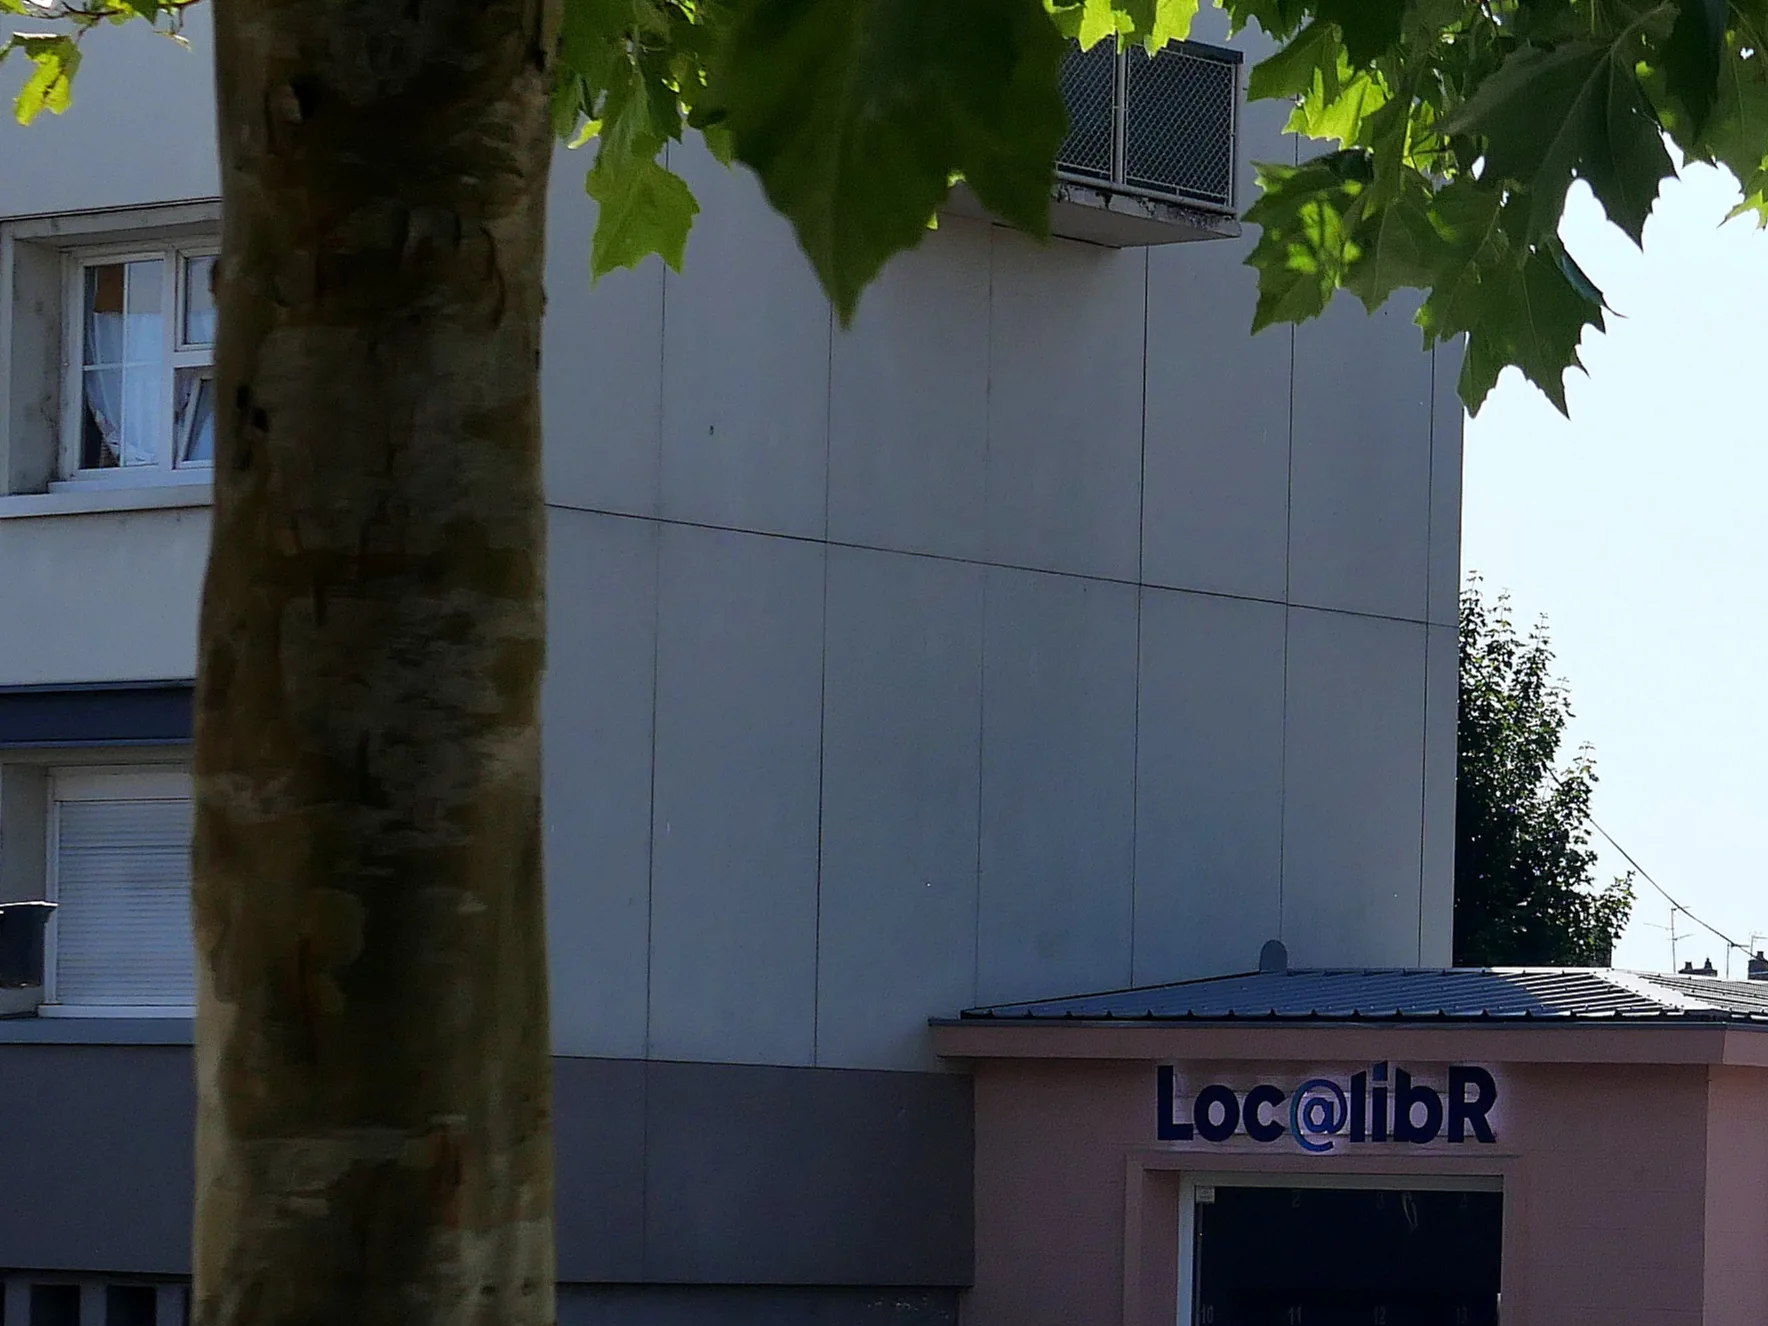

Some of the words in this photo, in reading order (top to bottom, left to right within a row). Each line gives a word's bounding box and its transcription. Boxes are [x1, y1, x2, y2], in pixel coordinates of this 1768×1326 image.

[1157, 1059, 1497, 1152] Loc@libR
[1200, 1303, 1214, 1325] 10
[1287, 1303, 1303, 1326] 11
[1373, 1305, 1387, 1326] 12
